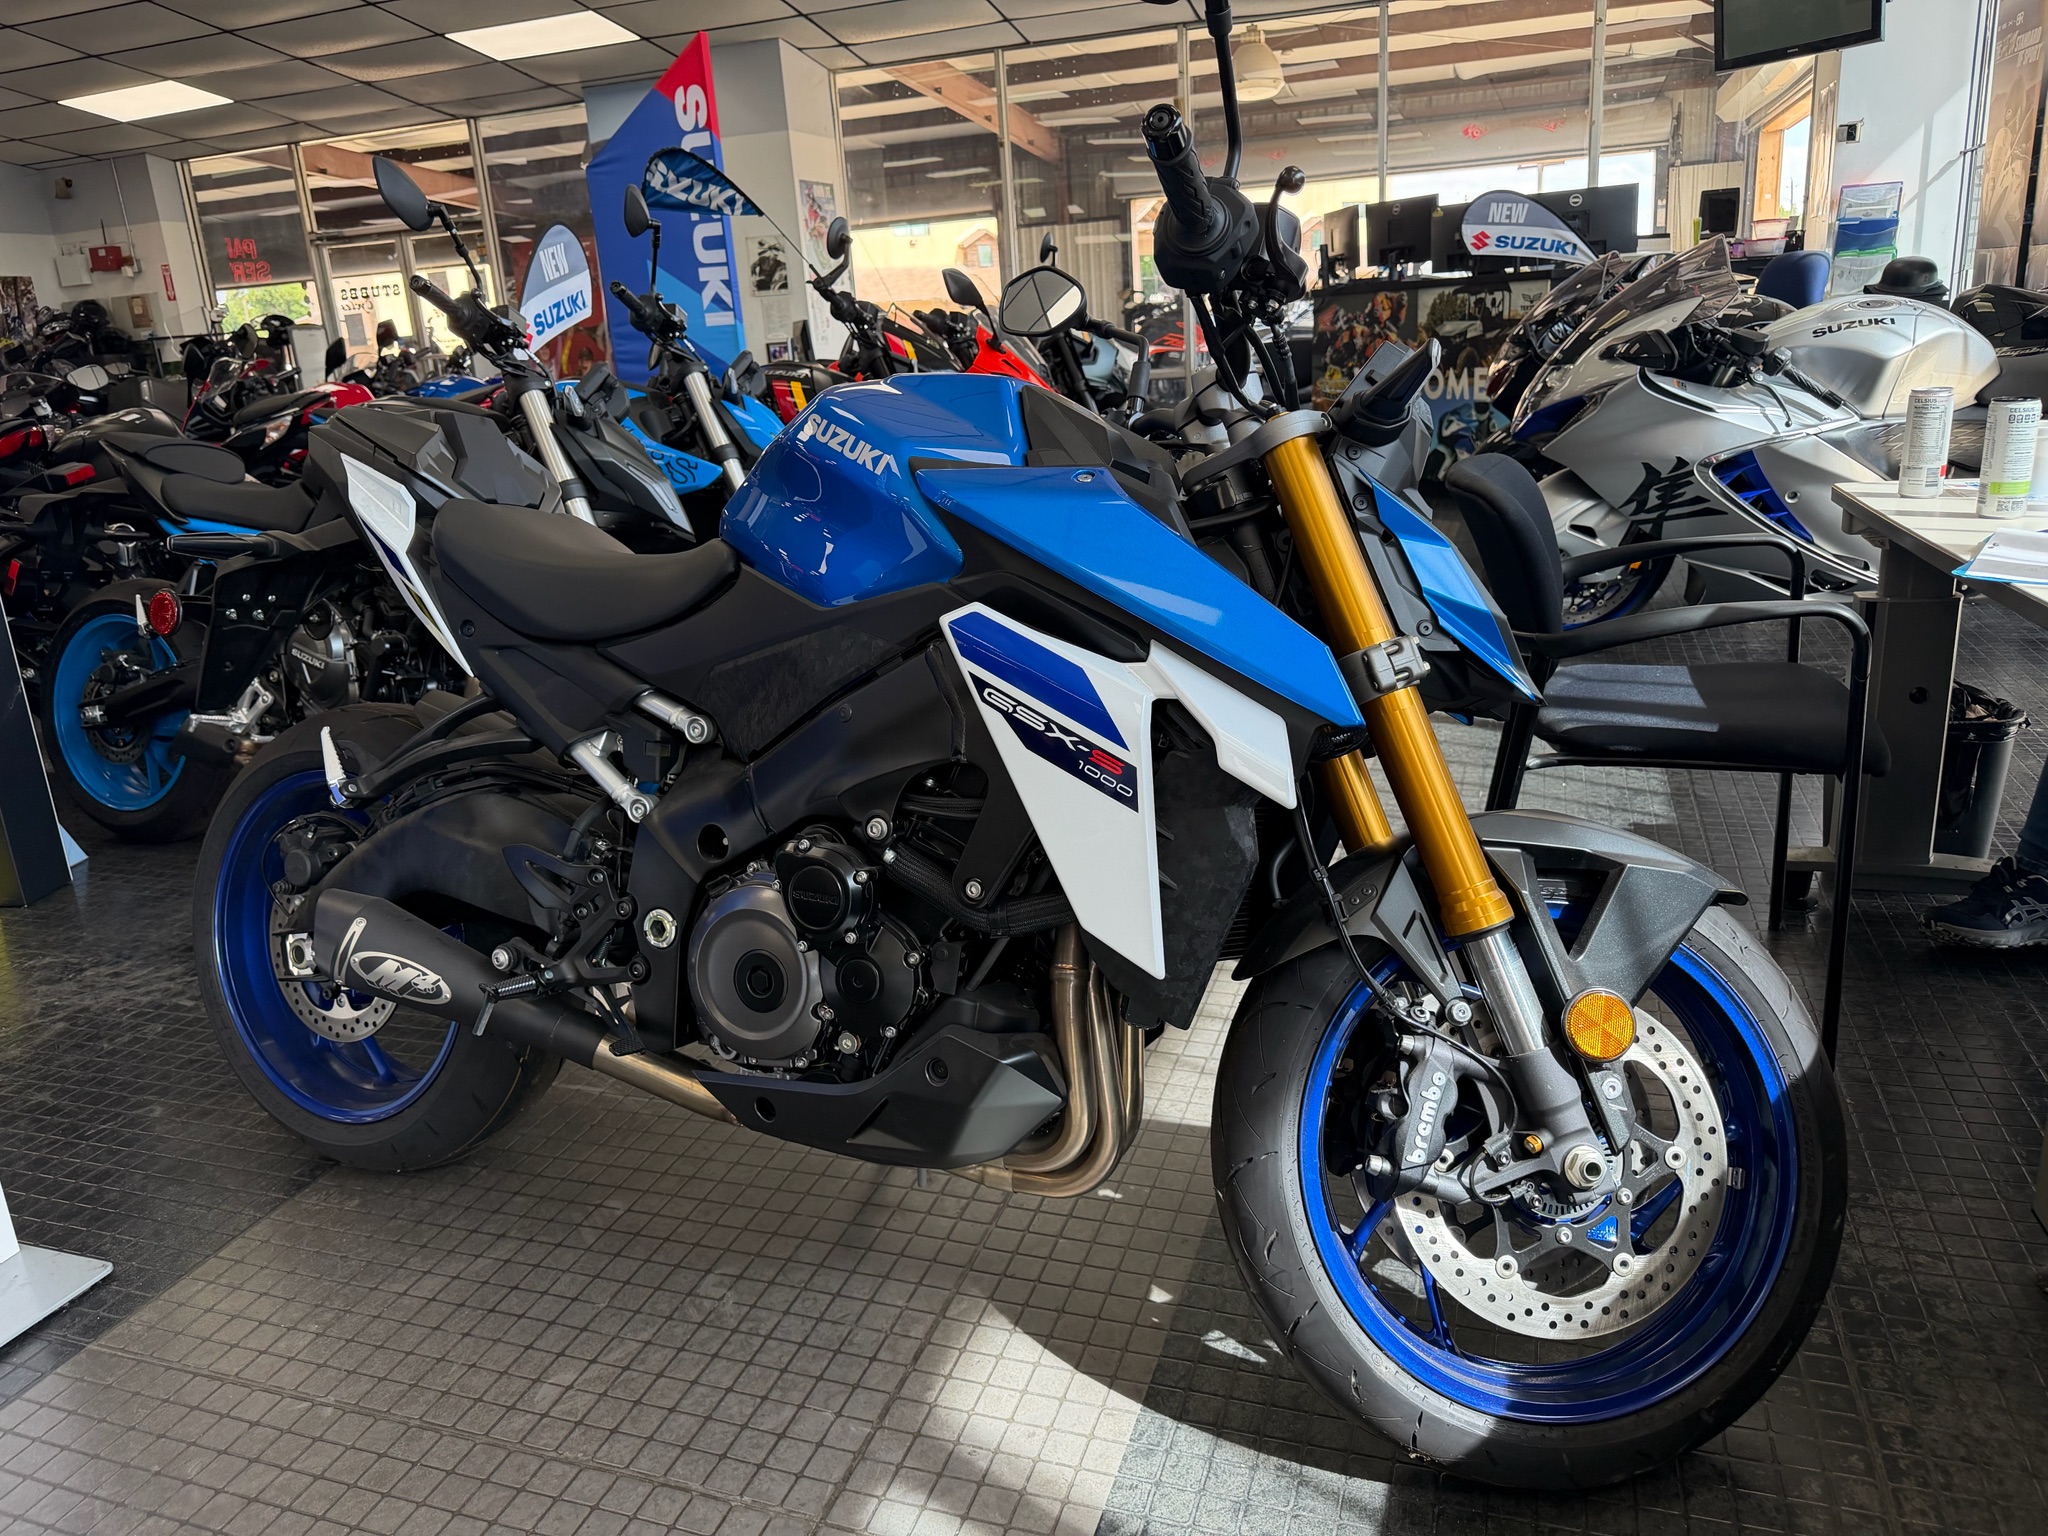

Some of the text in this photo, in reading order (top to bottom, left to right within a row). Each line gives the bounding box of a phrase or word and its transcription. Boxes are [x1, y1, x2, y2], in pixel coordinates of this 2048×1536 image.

[674, 83, 736, 327] SUUKI
[1487, 201, 1529, 224] NEW
[539, 242, 569, 282] NEW
[1494, 235, 1578, 255] SUZUKI
[533, 289, 586, 336] SUZUKI
[1812, 317, 1896, 338] SUZUKI
[803, 413, 884, 476] SUZUKI
[1617, 456, 1729, 541] 隼
[291, 648, 325, 669] SUZUKI
[983, 687, 1125, 775] GSX-S
[1078, 760, 1133, 797] 1000
[792, 890, 839, 906] SUZUKI
[1405, 1071, 1446, 1164] brembo
